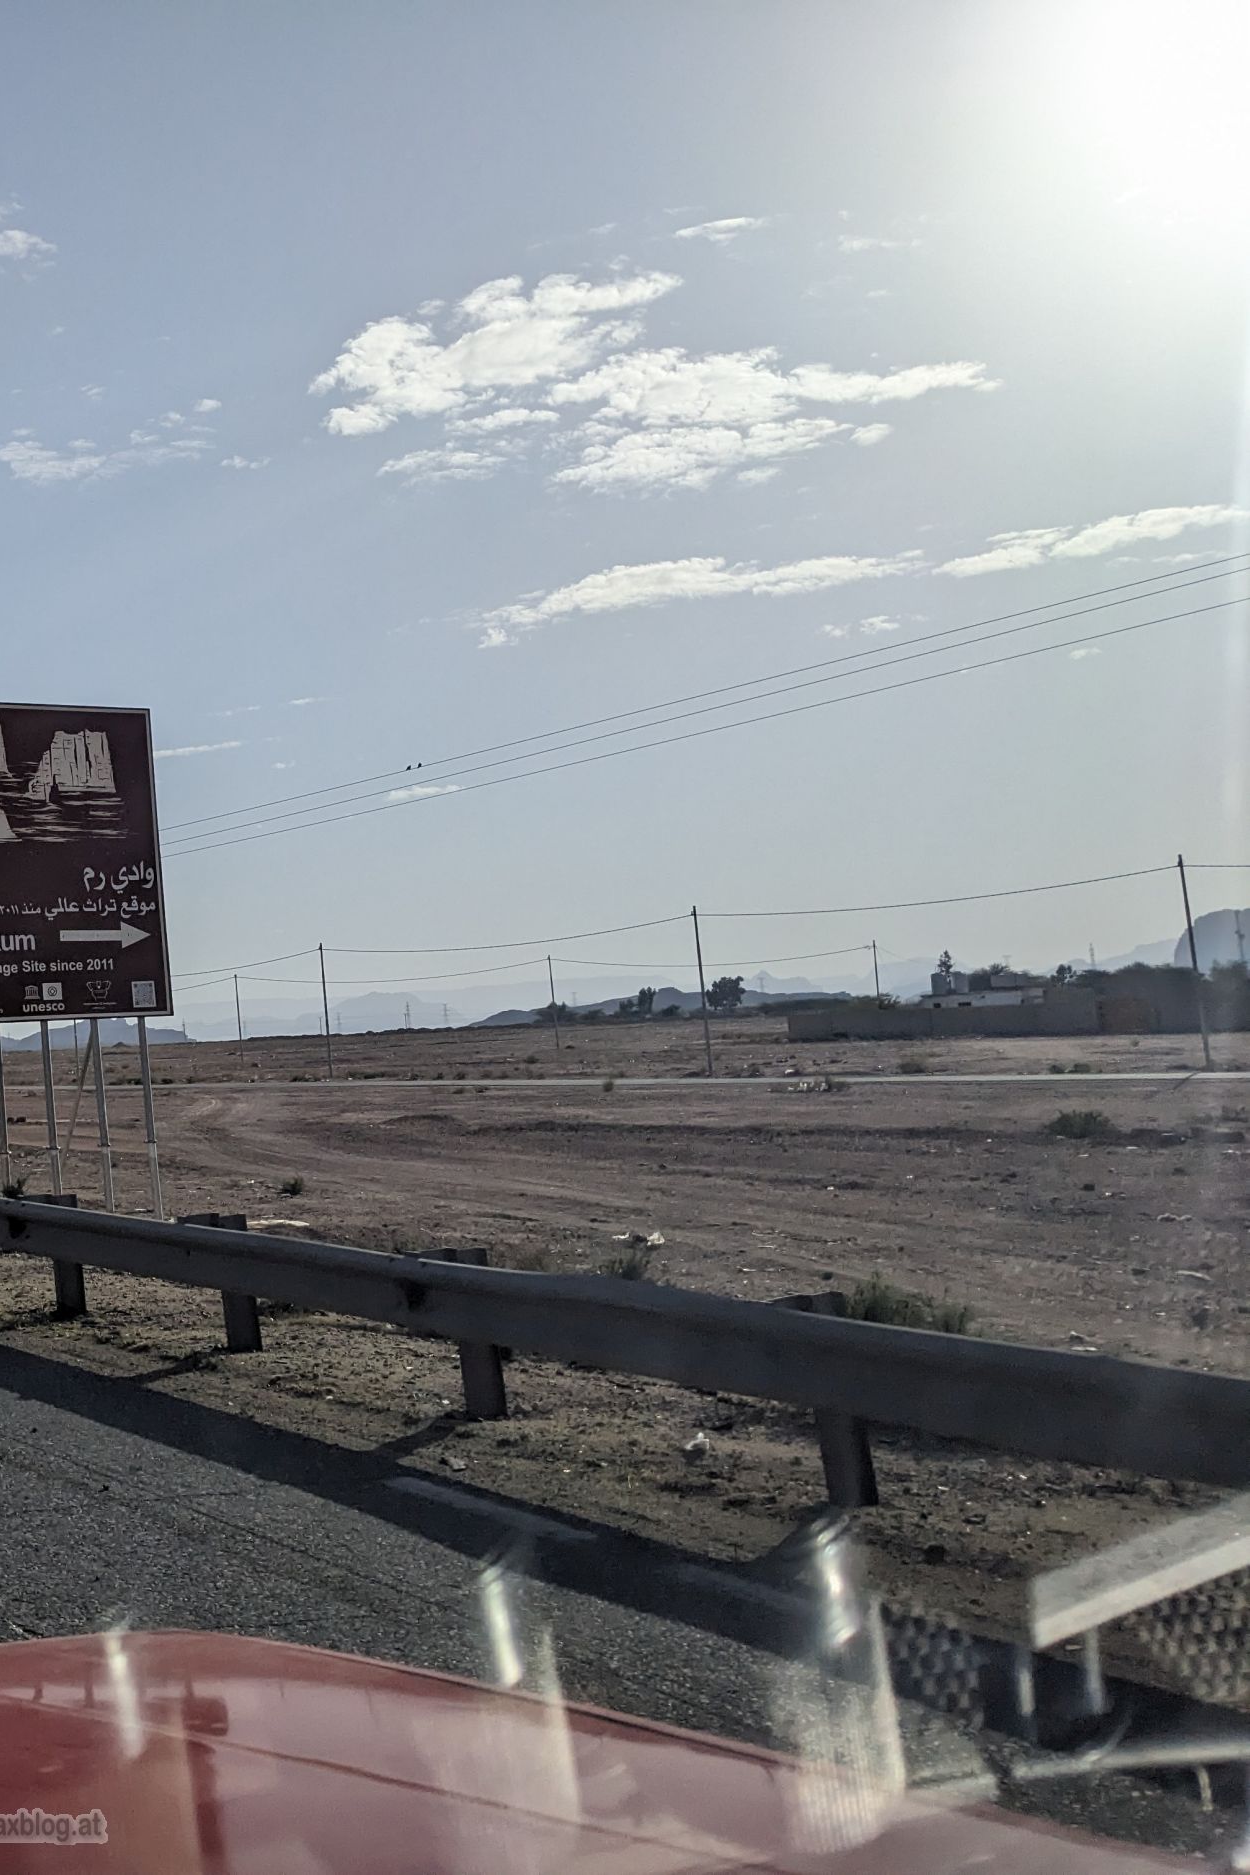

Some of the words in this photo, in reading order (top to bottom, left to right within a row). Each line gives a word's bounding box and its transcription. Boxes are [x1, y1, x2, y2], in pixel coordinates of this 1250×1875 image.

[83, 866, 106, 892] رم
[111, 860, 155, 894] وادي
[21, 902, 41, 915] منذ
[82, 898, 117, 917] تراث
[120, 896, 156, 919] موقع
[22, 960, 46, 972] Site
[50, 959, 83, 971] since
[86, 958, 114, 971] 2011
[22, 1002, 65, 1012] unesco
